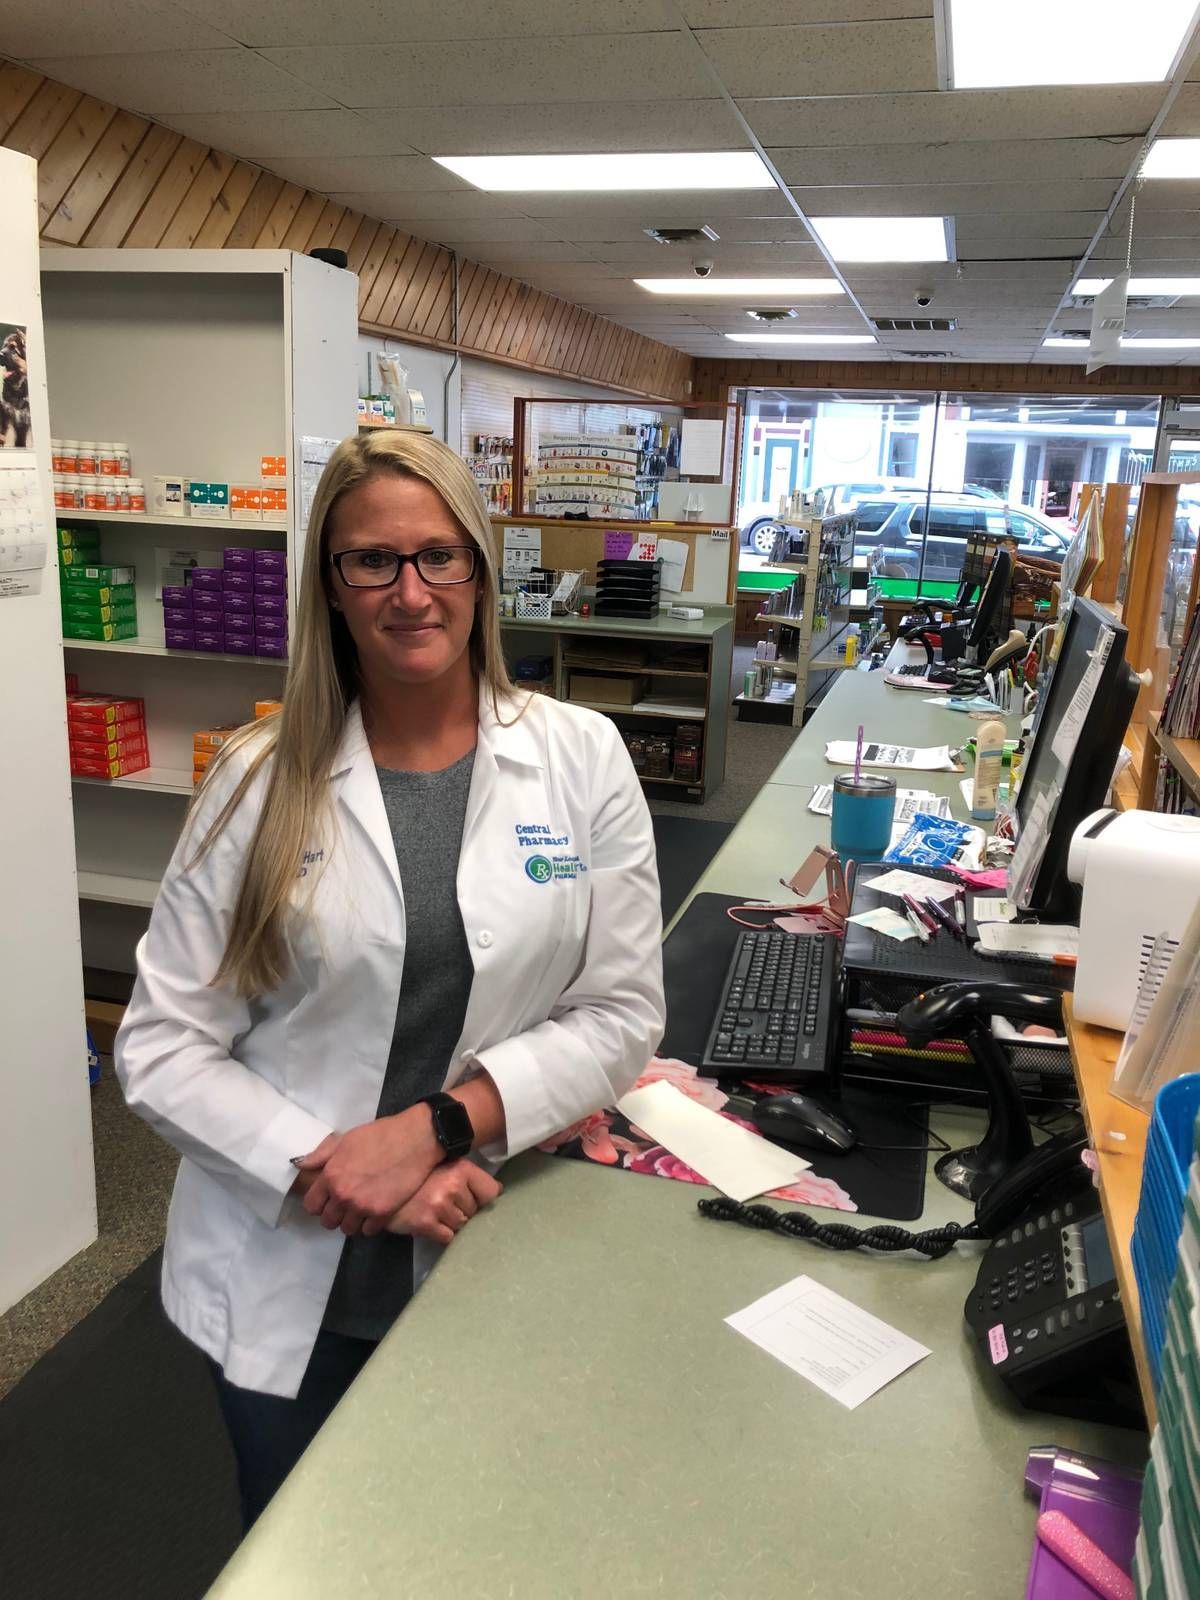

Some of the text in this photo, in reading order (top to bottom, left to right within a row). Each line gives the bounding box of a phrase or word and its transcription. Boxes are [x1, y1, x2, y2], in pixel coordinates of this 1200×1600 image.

[712, 530, 728, 538] Mail
[515, 824, 551, 834] Central
[519, 836, 569, 846] Pharmacy
[303, 849, 324, 864] Hart
